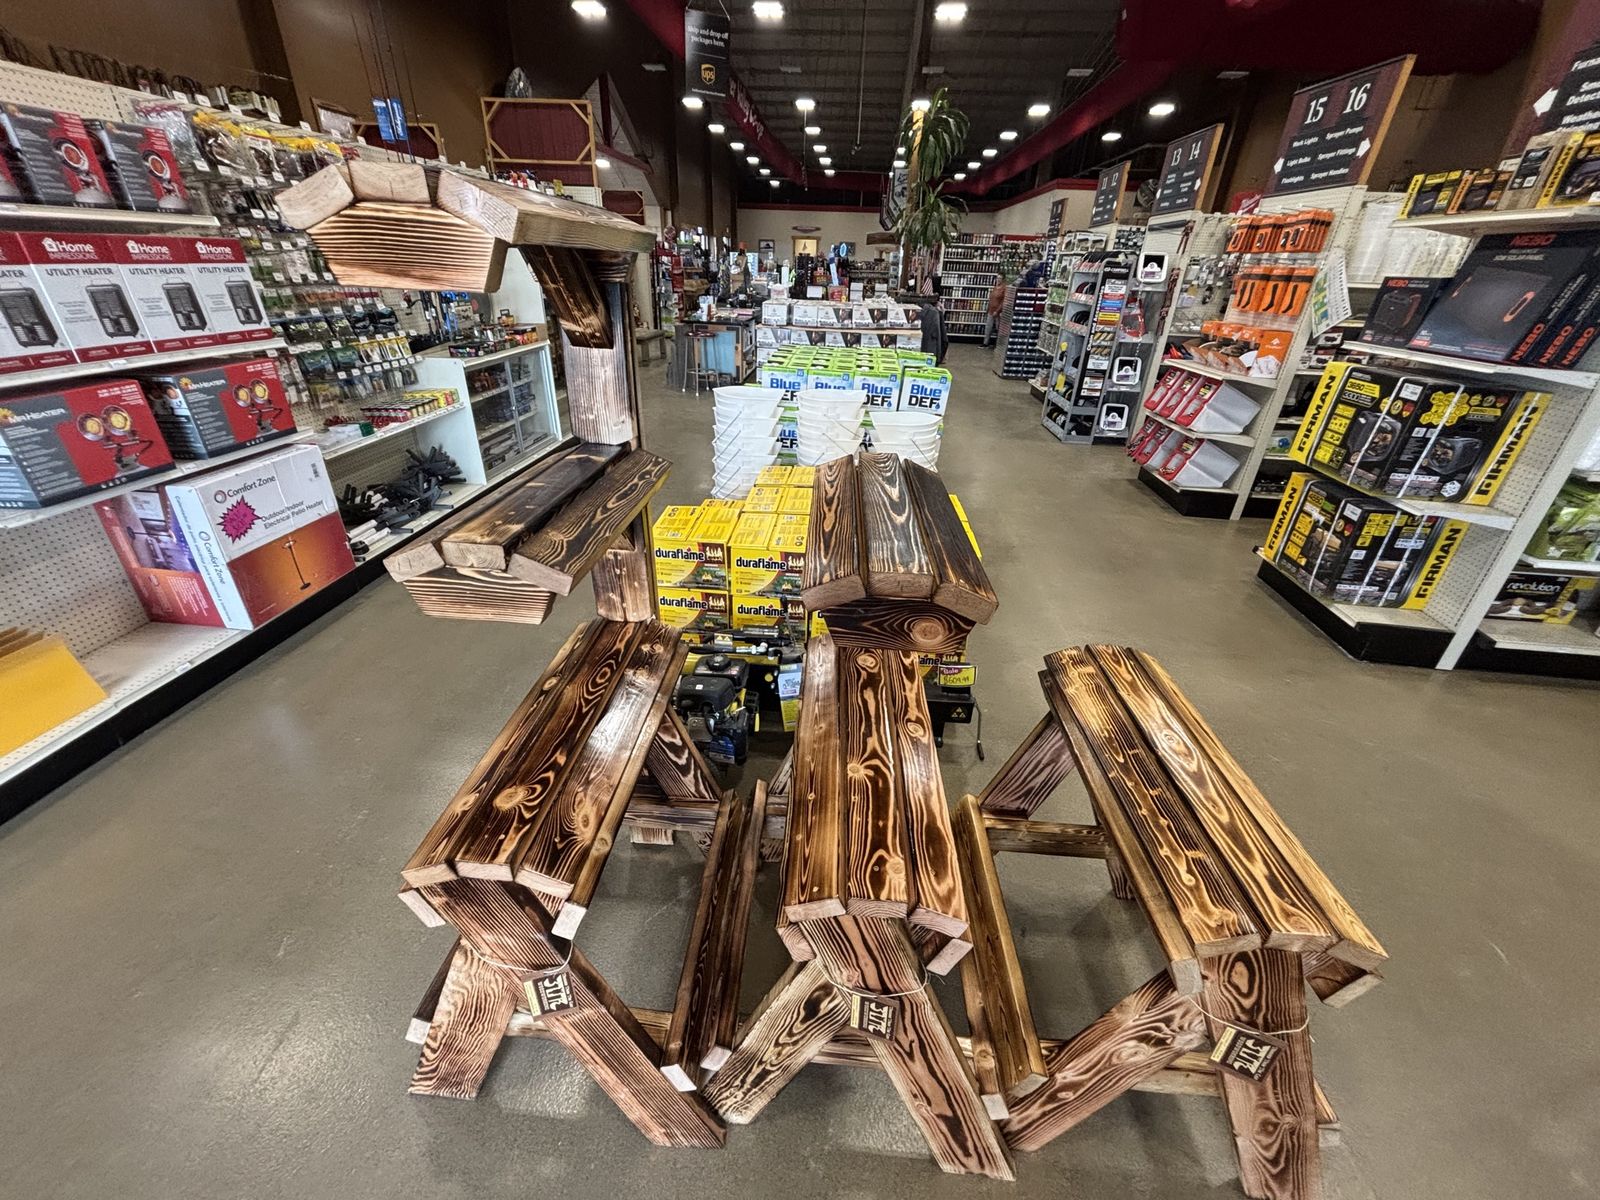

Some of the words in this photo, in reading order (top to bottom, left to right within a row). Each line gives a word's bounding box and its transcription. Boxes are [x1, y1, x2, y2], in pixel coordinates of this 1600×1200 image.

[1343, 83, 1371, 114] 16
[1304, 96, 1328, 124] 15
[1171, 148, 1182, 166] 13
[1188, 141, 1201, 160] 14
[57, 241, 94, 252] Home
[138, 243, 169, 254] Home
[206, 244, 232, 254] Home
[45, 268, 80, 276] UTILITY
[160, 267, 185, 275] HEATER
[1387, 279, 1408, 288] NEBO
[1511, 323, 1544, 361] NEBO
[1539, 325, 1573, 364] NEBO
[1561, 326, 1596, 366] NEBO
[770, 378, 800, 390] Blue
[862, 383, 893, 395] Blue
[910, 384, 942, 397] Blue
[1347, 381, 1365, 391] 3650
[908, 395, 940, 408] DEF
[1298, 375, 1336, 452] FIRMAN
[1475, 406, 1539, 495] FIRMAN
[227, 482, 257, 498] Comfort
[258, 475, 276, 487] Zone
[263, 514, 291, 530] Electrical
[291, 508, 305, 518] Patio
[305, 500, 324, 511] Heater
[1268, 487, 1298, 551] FIRMAN
[655, 547, 705, 561] duraflame
[203, 542, 219, 572] Comfort
[214, 568, 226, 585] Zone
[736, 556, 786, 571] duraflame
[1415, 528, 1462, 598] FIRMAN
[1506, 582, 1560, 593] revolution
[660, 596, 707, 610] duraflame
[737, 604, 785, 617] duraflame
